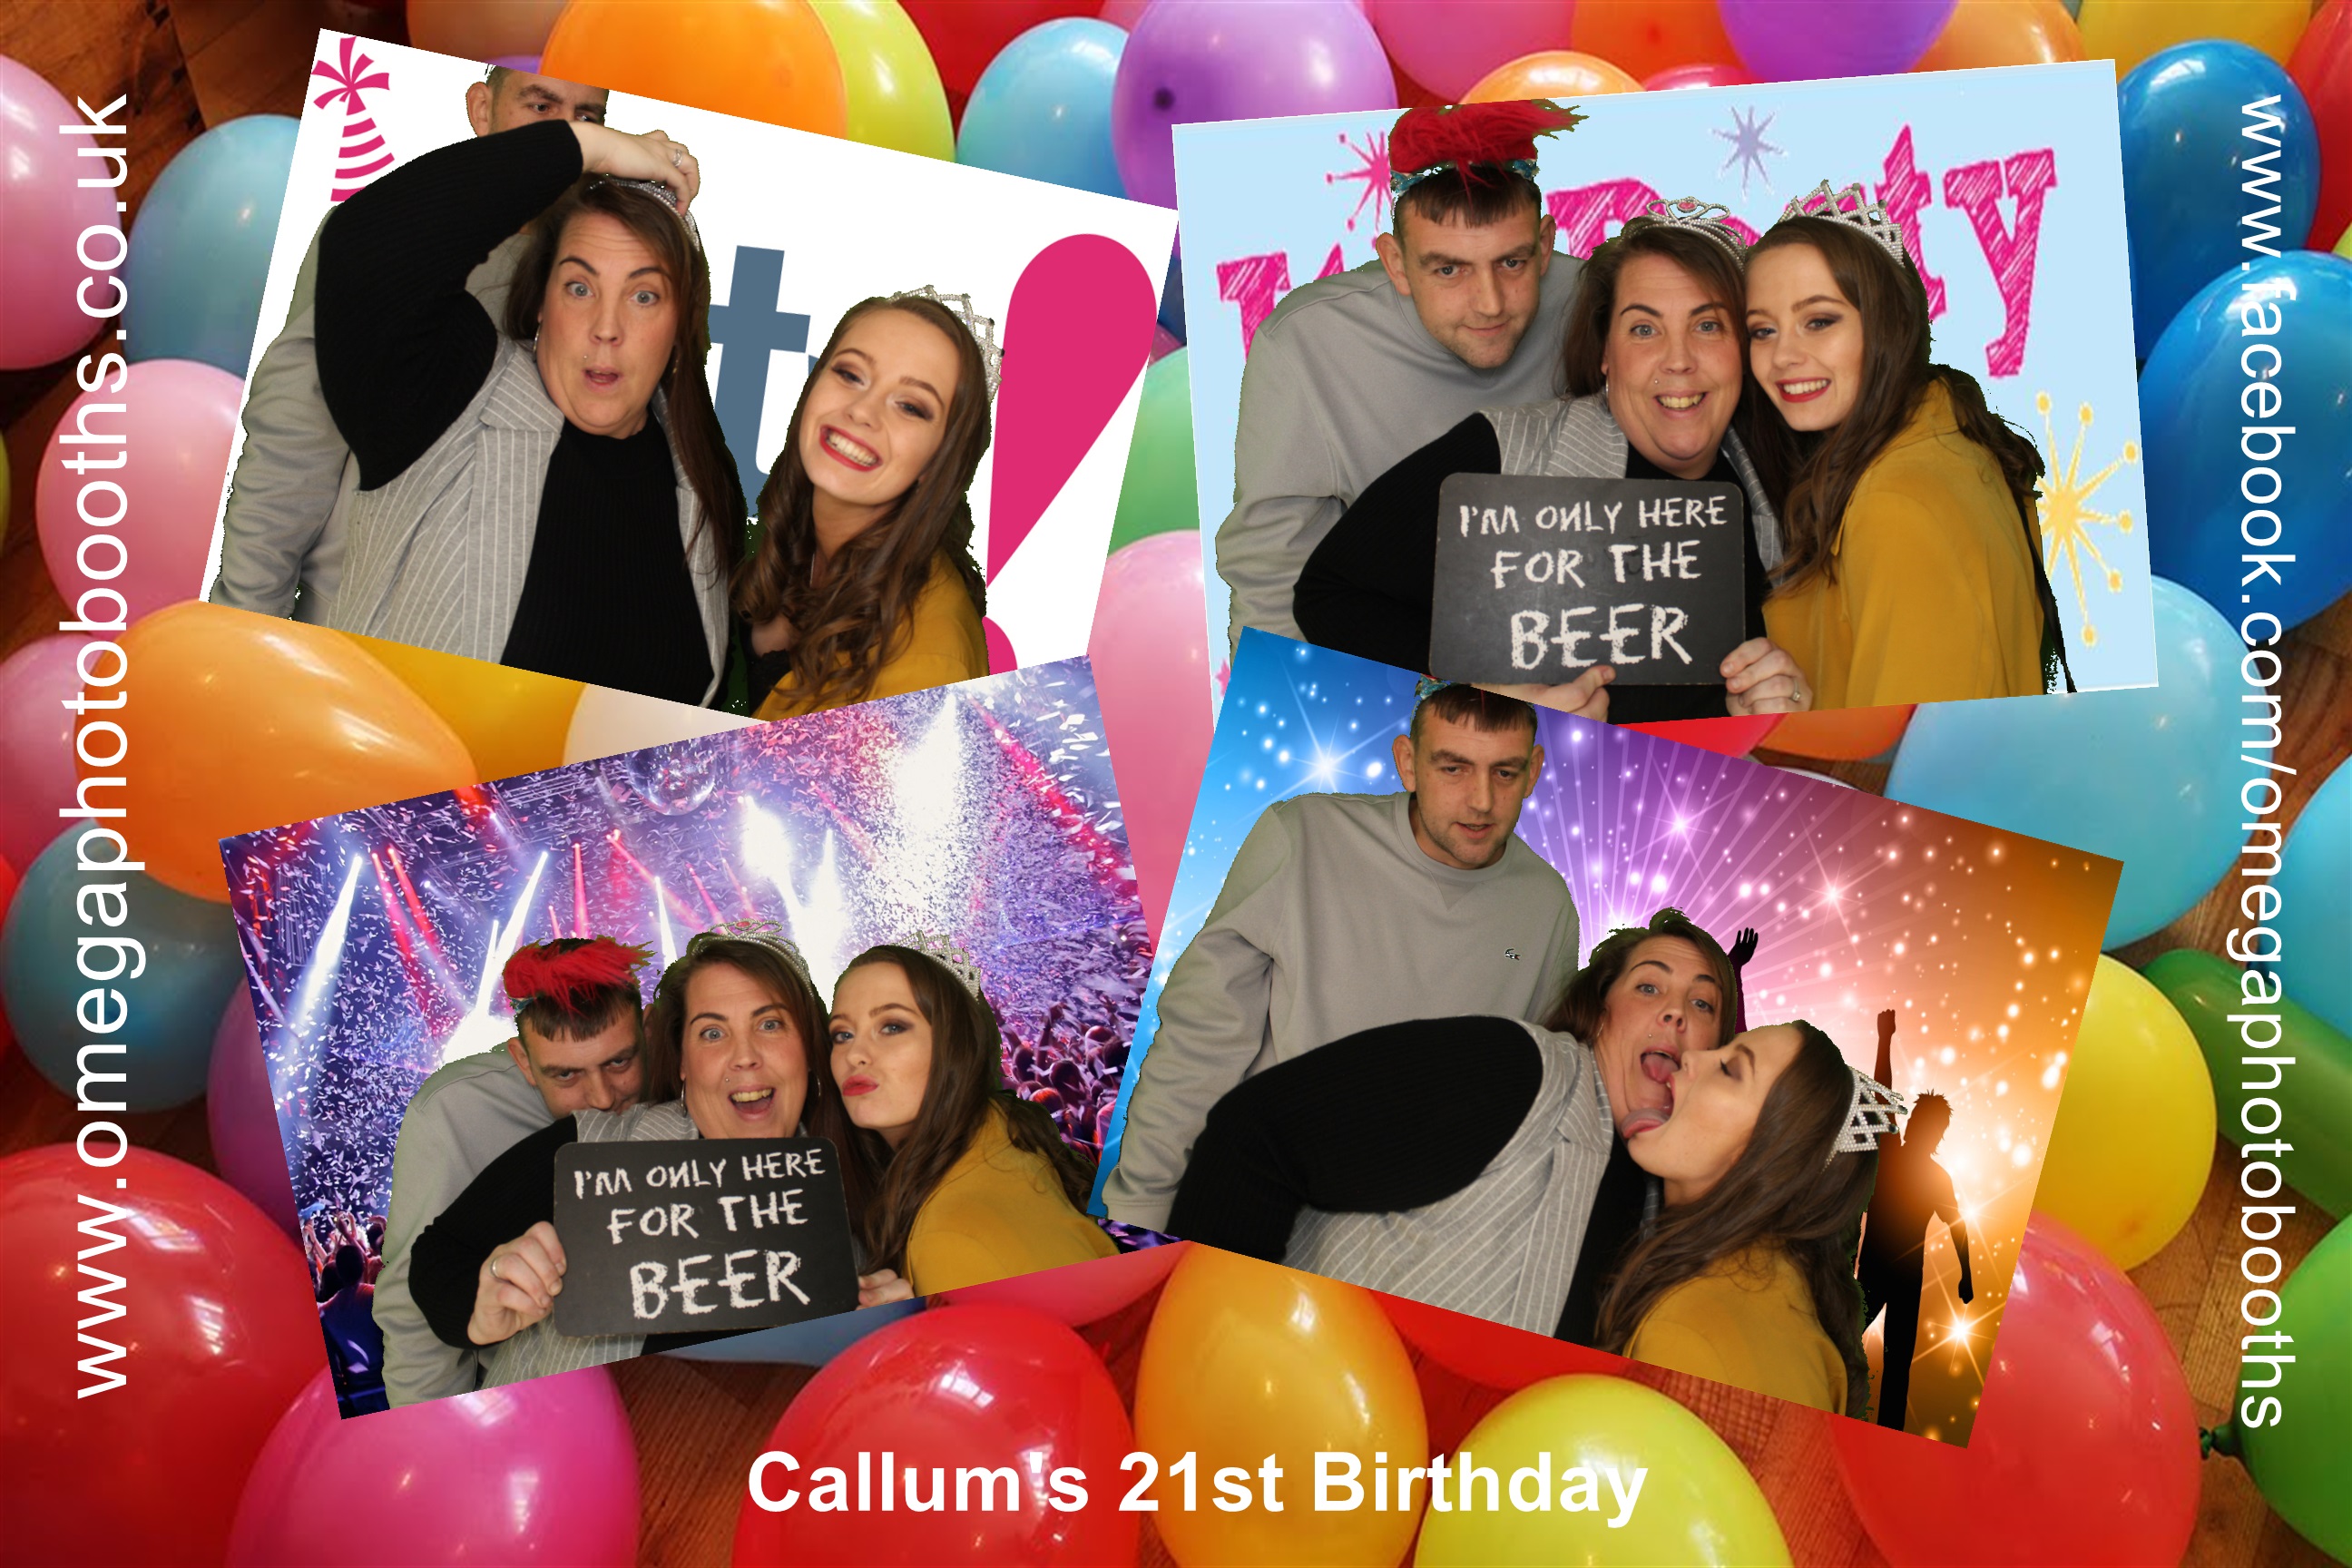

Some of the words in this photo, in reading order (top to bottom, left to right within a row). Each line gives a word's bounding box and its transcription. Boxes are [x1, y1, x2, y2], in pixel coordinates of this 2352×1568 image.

[1459, 505, 1520, 537] I'M
[1535, 500, 1622, 534] ONLY
[1639, 495, 1727, 528] HERE
[1490, 549, 1585, 589] FOR
[1607, 539, 1701, 583] THE
[1510, 603, 1692, 670] BEER
[573, 1168, 632, 1200] I'M
[646, 1158, 727, 1189] ONLY
[742, 1148, 826, 1181] HERE
[606, 1202, 700, 1245] FOR
[718, 1188, 808, 1232] THE
[630, 1249, 810, 1319] BEER
